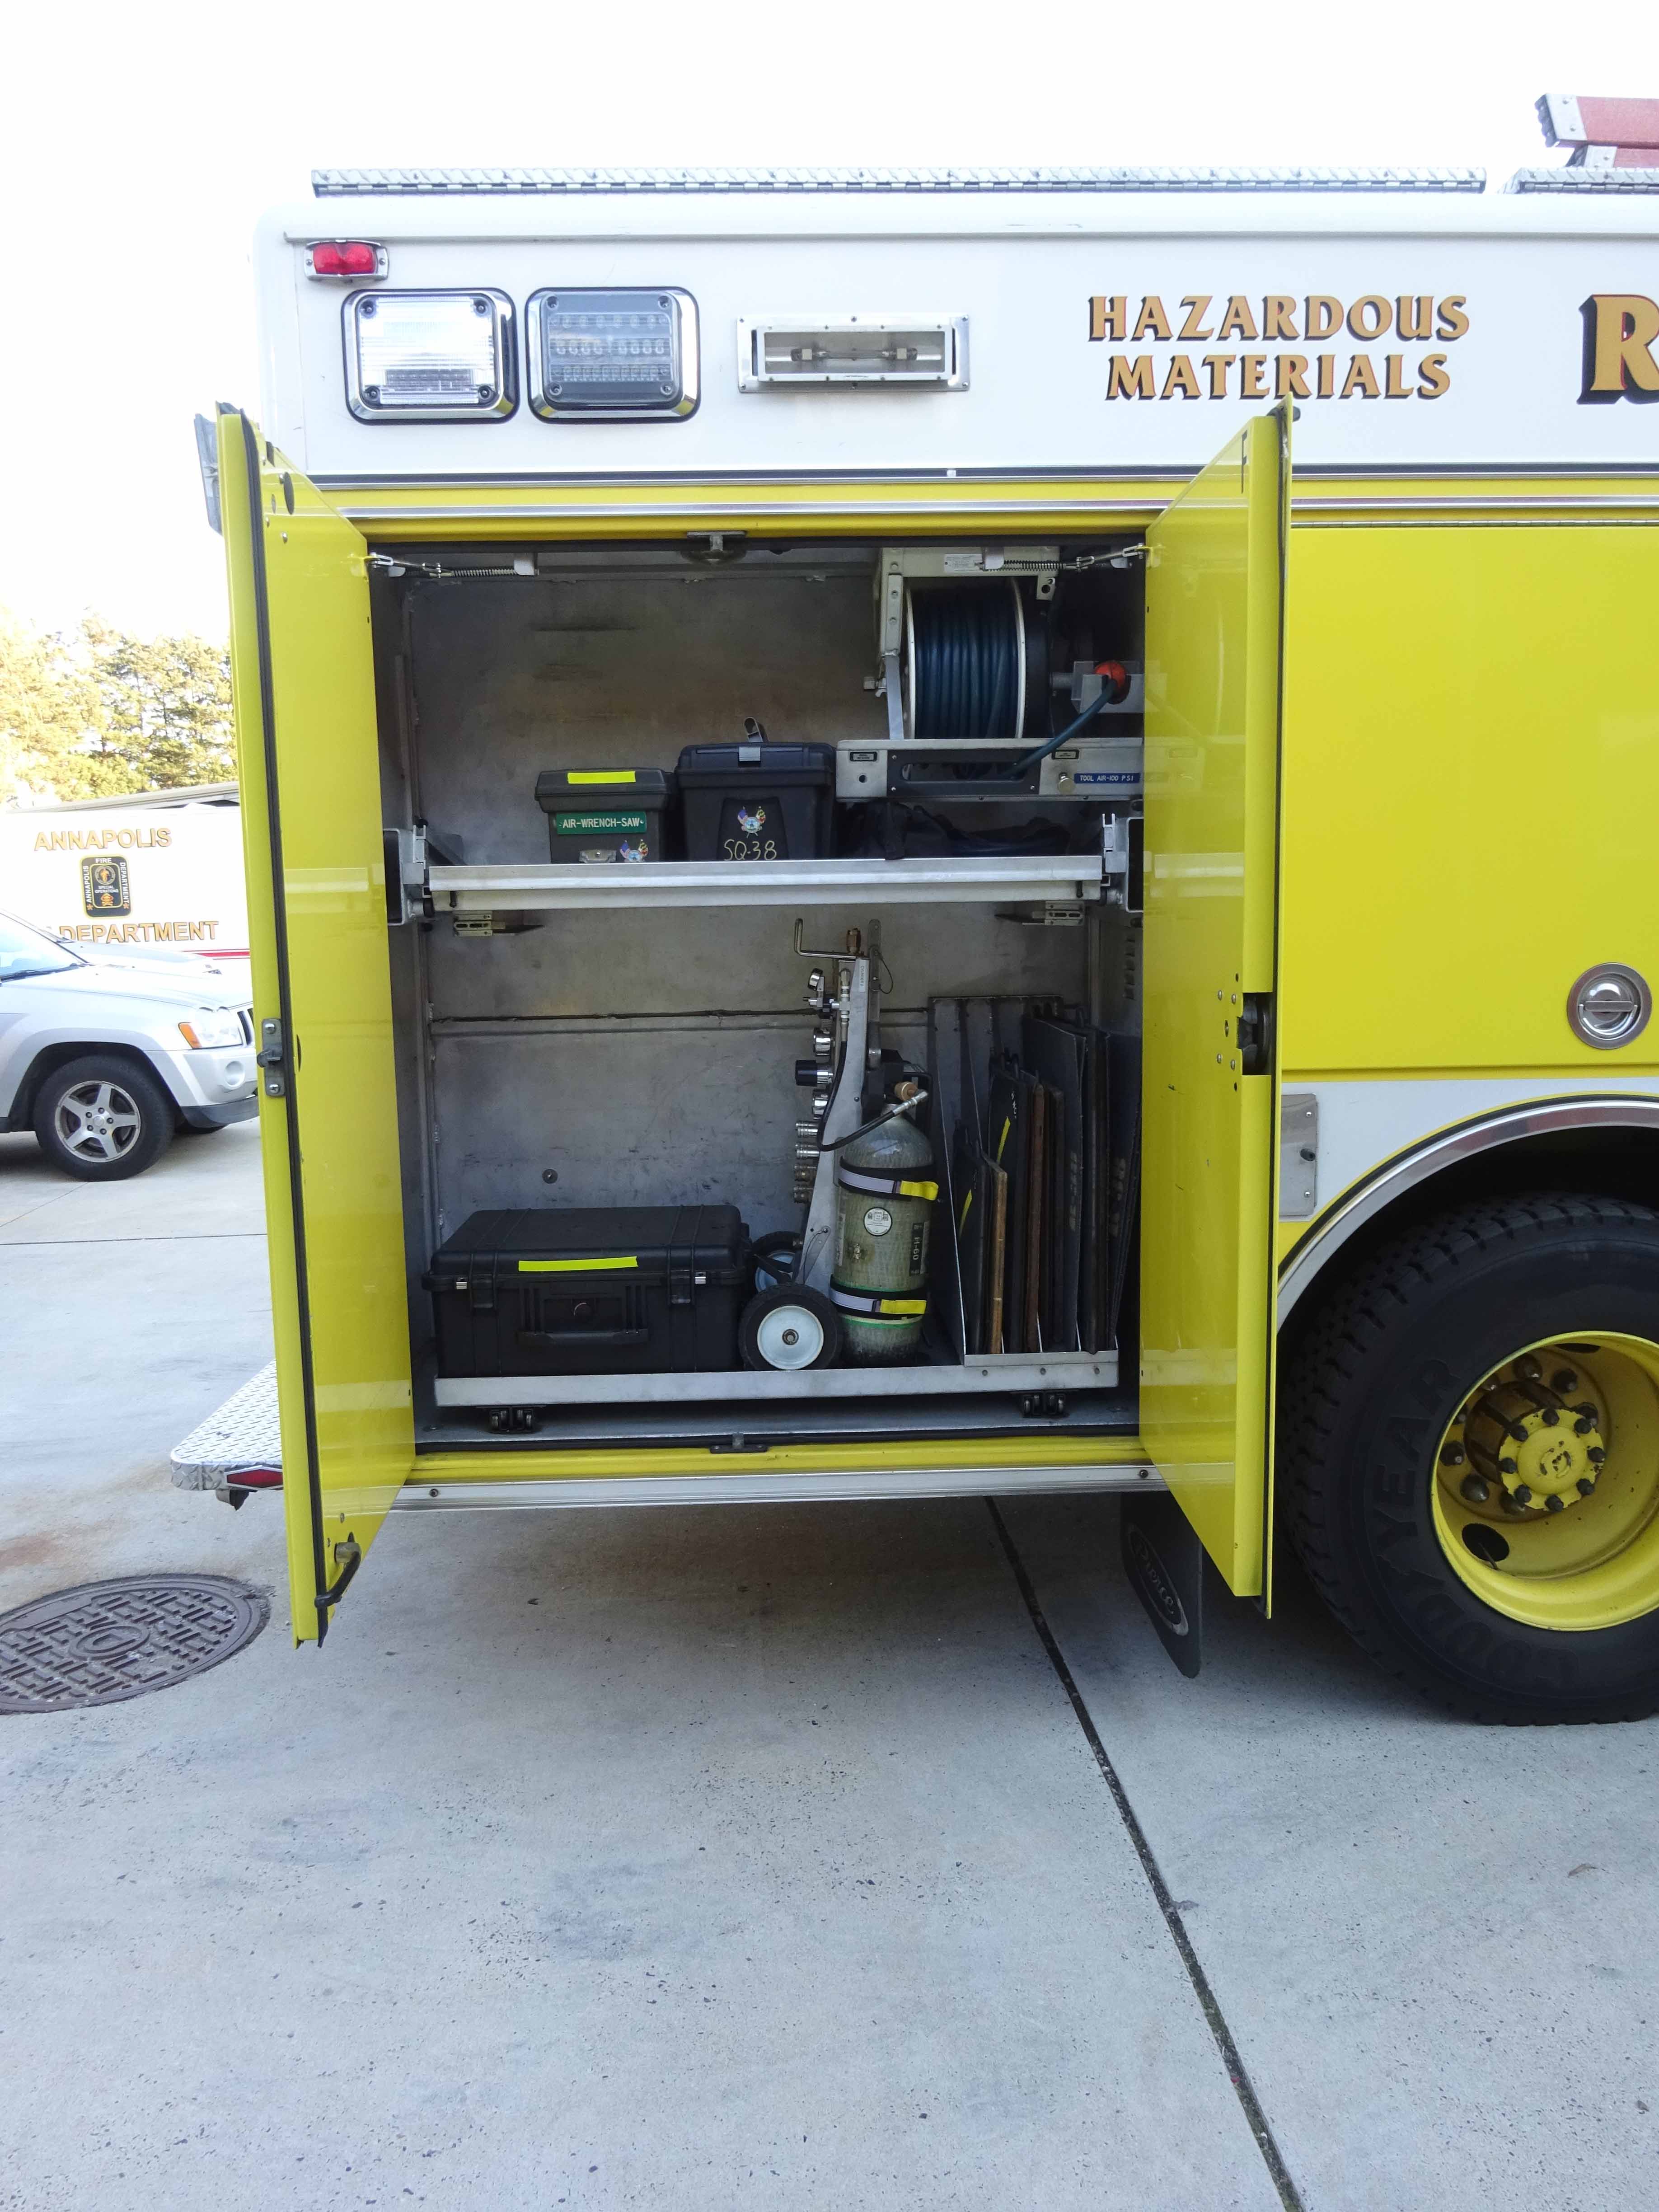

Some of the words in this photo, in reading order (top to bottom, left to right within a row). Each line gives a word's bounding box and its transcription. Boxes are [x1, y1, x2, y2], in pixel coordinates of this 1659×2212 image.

[1087, 294, 1470, 342] HAZARDOUS
[1105, 354, 1451, 401] MATERIALS
[562, 817, 641, 829] AIR-WRENCH-SAW
[34, 827, 173, 851] ANNAPOLIS
[723, 839, 777, 861] SQ-38
[83, 866, 92, 903] ANNAPOLIS
[120, 862, 130, 903] DEPARTMENT
[59, 921, 219, 943] DEPARTMENT
